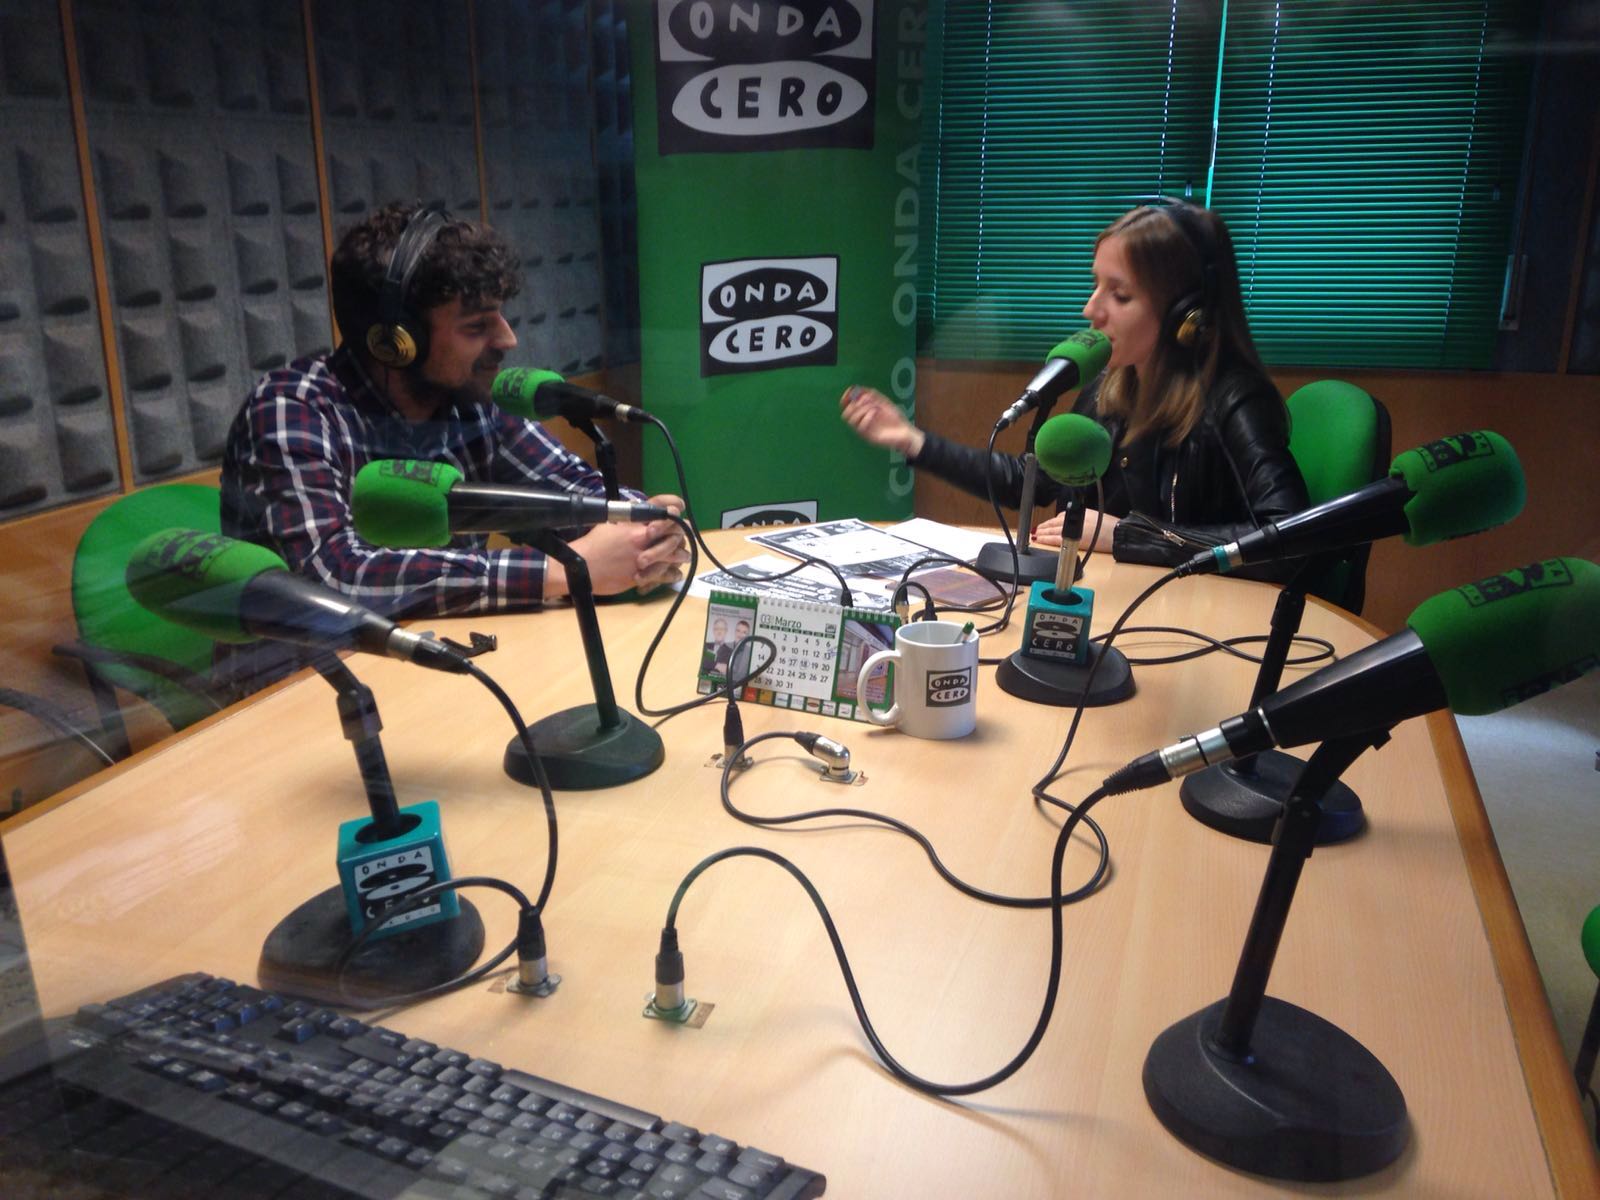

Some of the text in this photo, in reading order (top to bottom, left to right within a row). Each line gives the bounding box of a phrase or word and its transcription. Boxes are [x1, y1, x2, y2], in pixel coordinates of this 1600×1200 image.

[689, 5, 843, 40] ONDA
[699, 76, 843, 120] CERO
[892, 143, 922, 327] ONDA
[719, 281, 817, 309] ONDA
[725, 324, 817, 355] CERO
[889, 356, 917, 497] CO
[775, 615, 802, 629] Marzo
[1039, 614, 1078, 625] ONDA
[1032, 638, 1073, 650] CERO
[361, 850, 423, 876] ONDA
